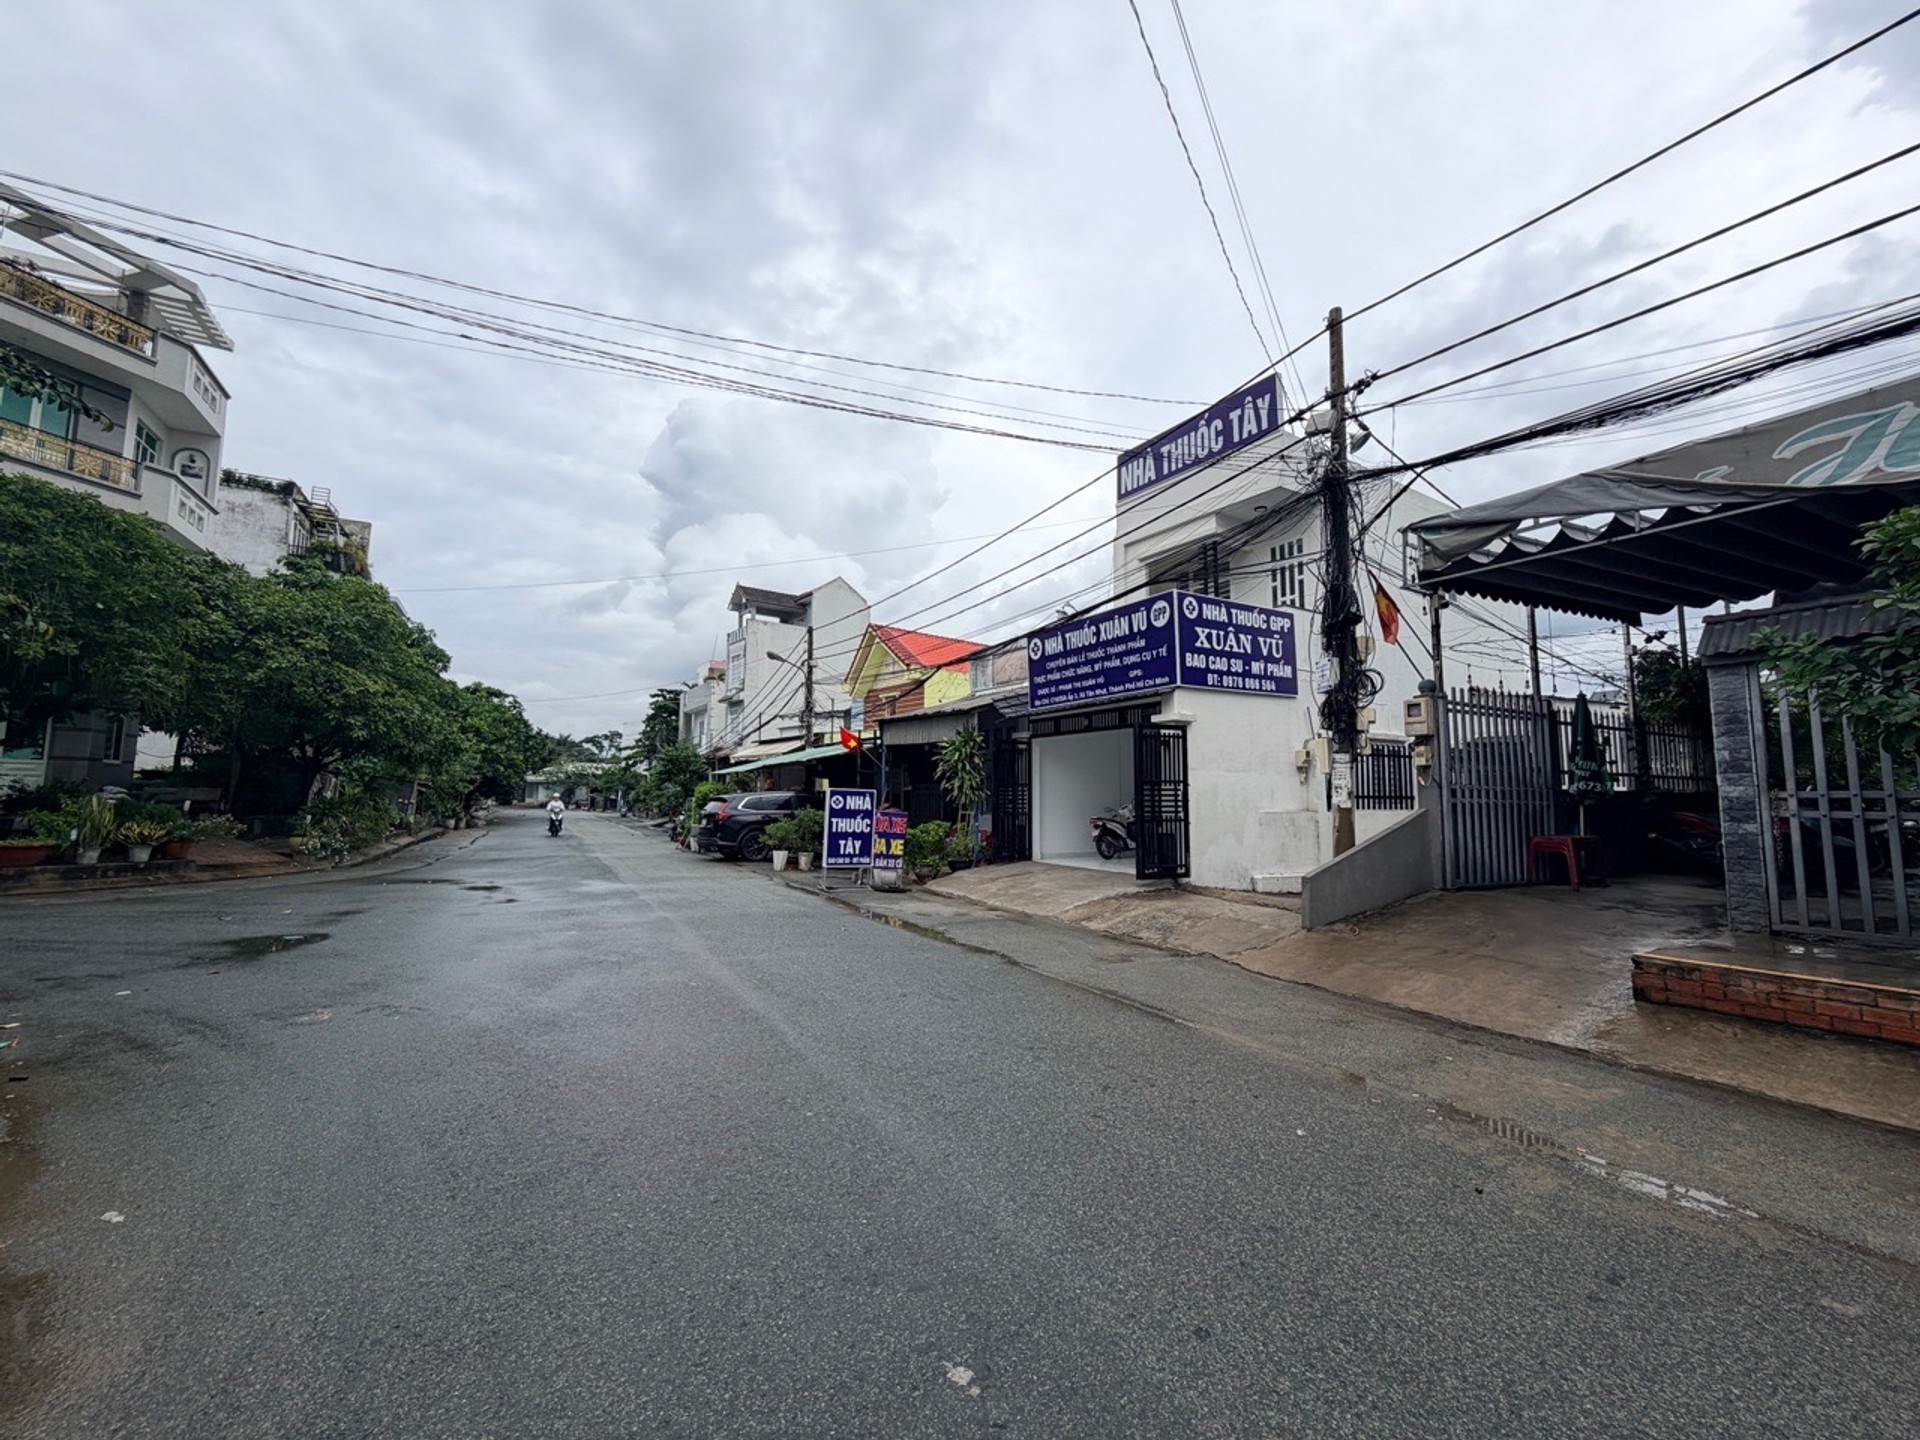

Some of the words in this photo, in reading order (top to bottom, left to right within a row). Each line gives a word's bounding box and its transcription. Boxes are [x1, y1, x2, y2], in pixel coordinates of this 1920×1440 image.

[1120, 448, 1156, 494] NHÀ
[1160, 413, 1224, 475] THUỐC
[1229, 394, 1271, 442] TÂY
[1153, 605, 1168, 620] GPP
[1202, 603, 1228, 623] NHÀ
[1230, 608, 1267, 630] THUỐC
[1269, 616, 1291, 632] GPP
[1044, 631, 1064, 656] NHÀ
[1065, 620, 1097, 651] THUỐC
[1099, 615, 1129, 641] XUÂN
[1131, 607, 1147, 633] VŨ
[1152, 649, 1157, 658] Y
[1158, 643, 1168, 657] TẾ
[1194, 626, 1252, 654] XUÂN
[1257, 634, 1283, 658] VŨ
[1185, 652, 1206, 669] BAO
[1208, 655, 1228, 672] CAO
[1230, 658, 1243, 674] SU
[1251, 660, 1265, 676] MỸ
[1267, 660, 1293, 678] PHẨM
[846, 793, 872, 810] NHÀ
[831, 813, 871, 833] THUỐC
[839, 837, 862, 855] TÂY
[889, 838, 904, 856] XE
